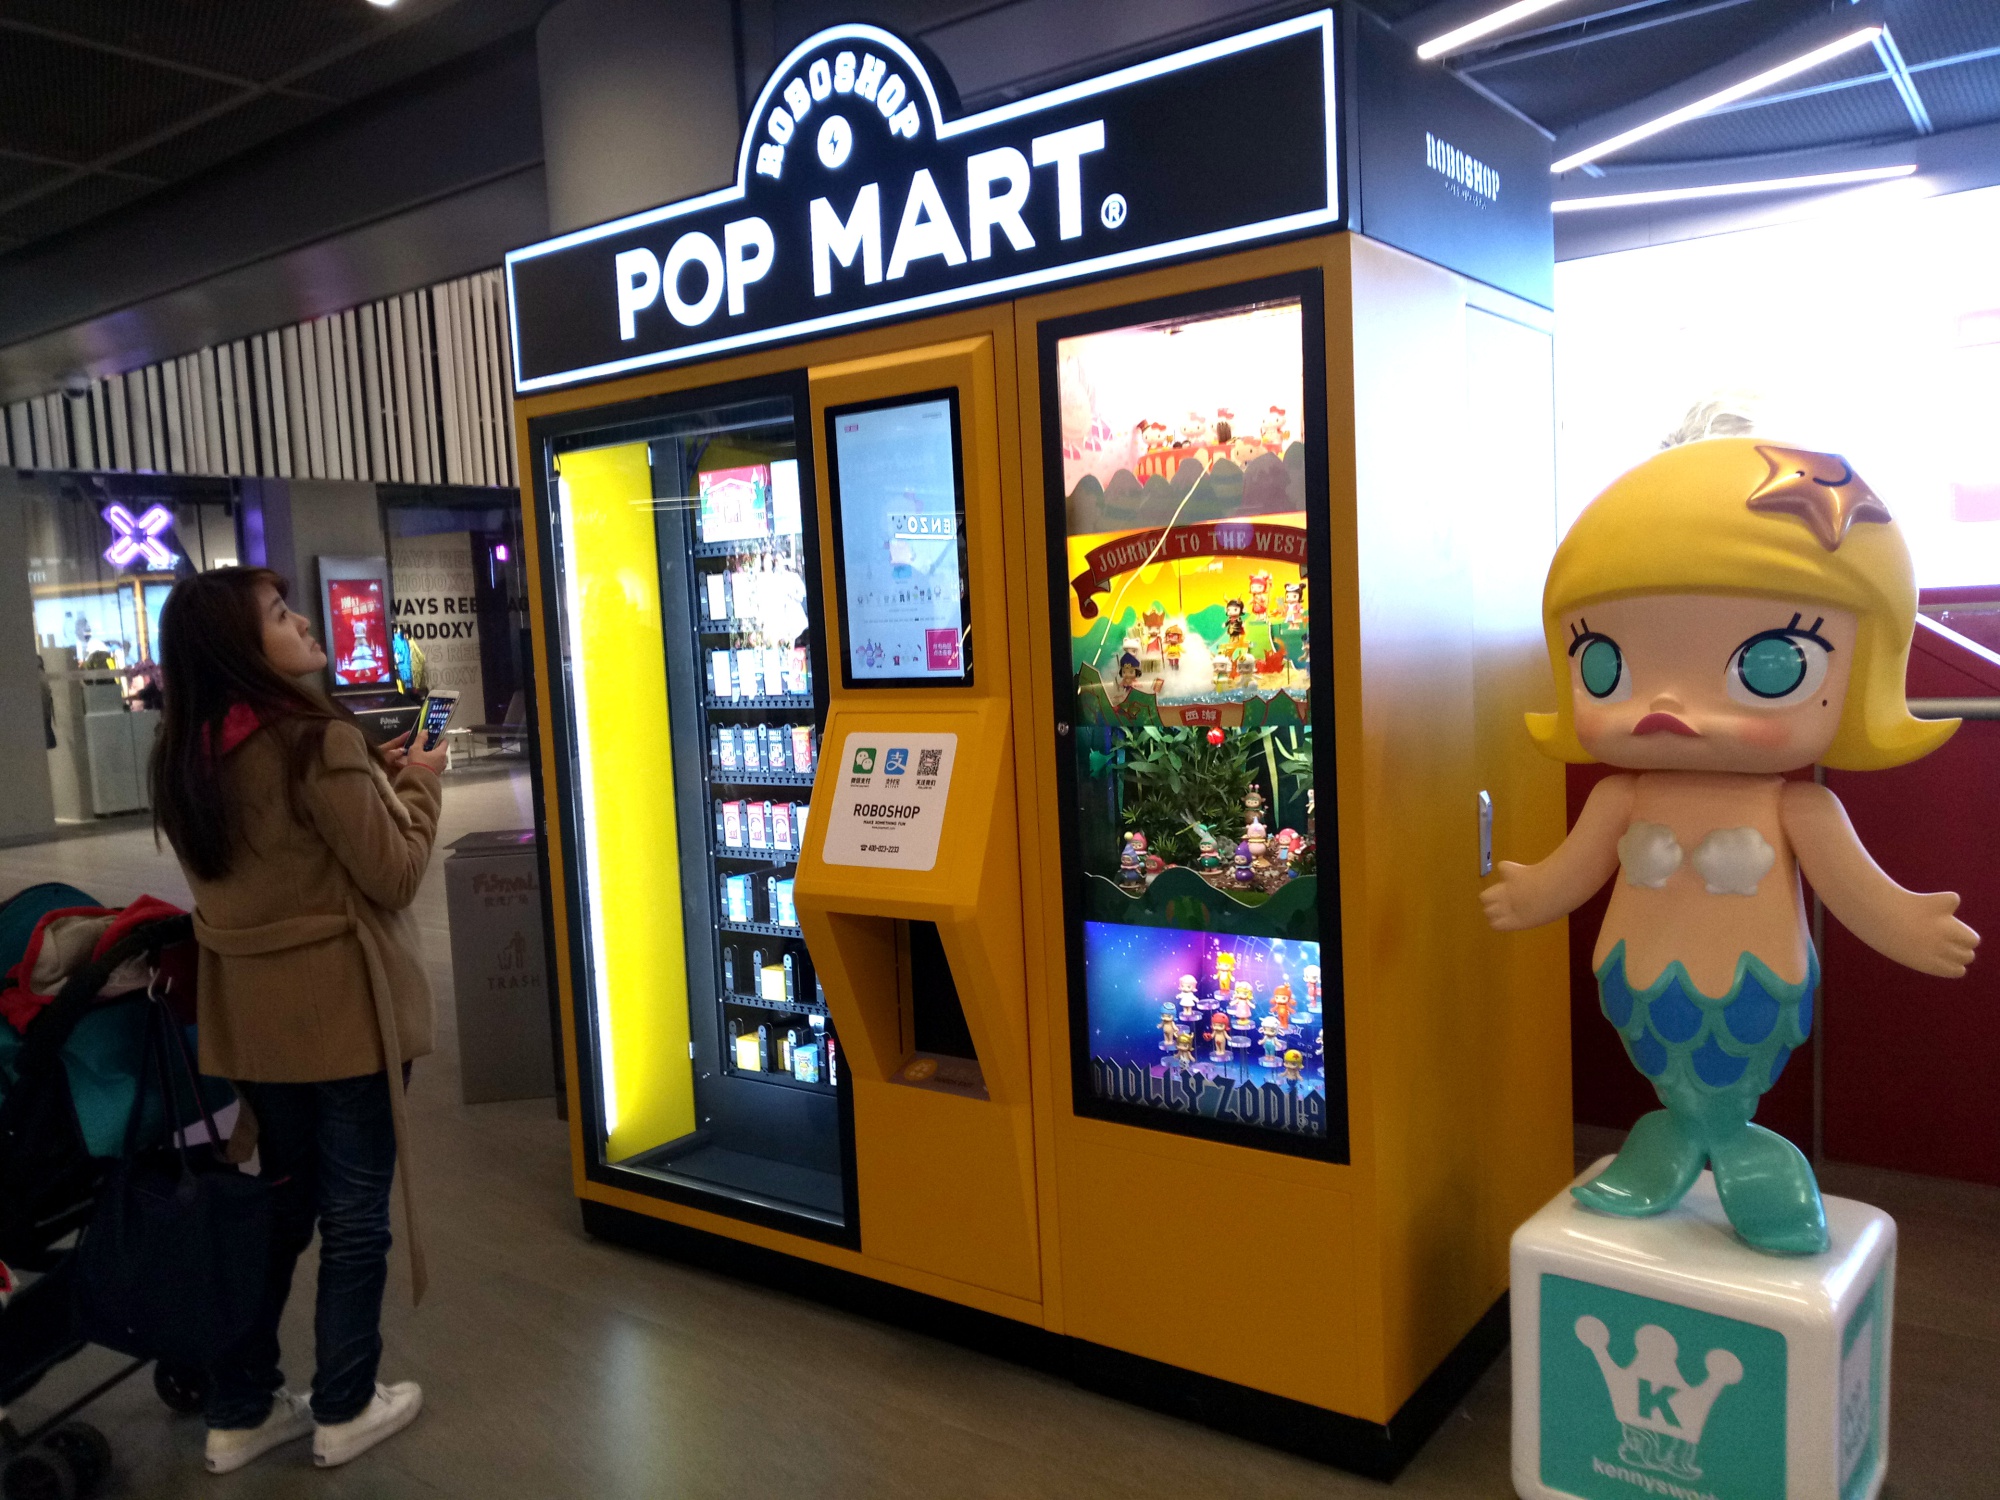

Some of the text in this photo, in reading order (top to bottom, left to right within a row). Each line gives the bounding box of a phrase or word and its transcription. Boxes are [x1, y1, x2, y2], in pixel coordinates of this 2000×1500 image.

[756, 51, 921, 179] ROBOSHOP
[1426, 131, 1500, 202] ROBOSHOP
[615, 216, 775, 341] POP
[809, 119, 1105, 296] MART
[1098, 531, 1307, 574] JOURNEY TO THE WEST
[853, 803, 921, 819] ROBOSHOP
[487, 975, 540, 990] TRASH
[1637, 1378, 1682, 1429] K
